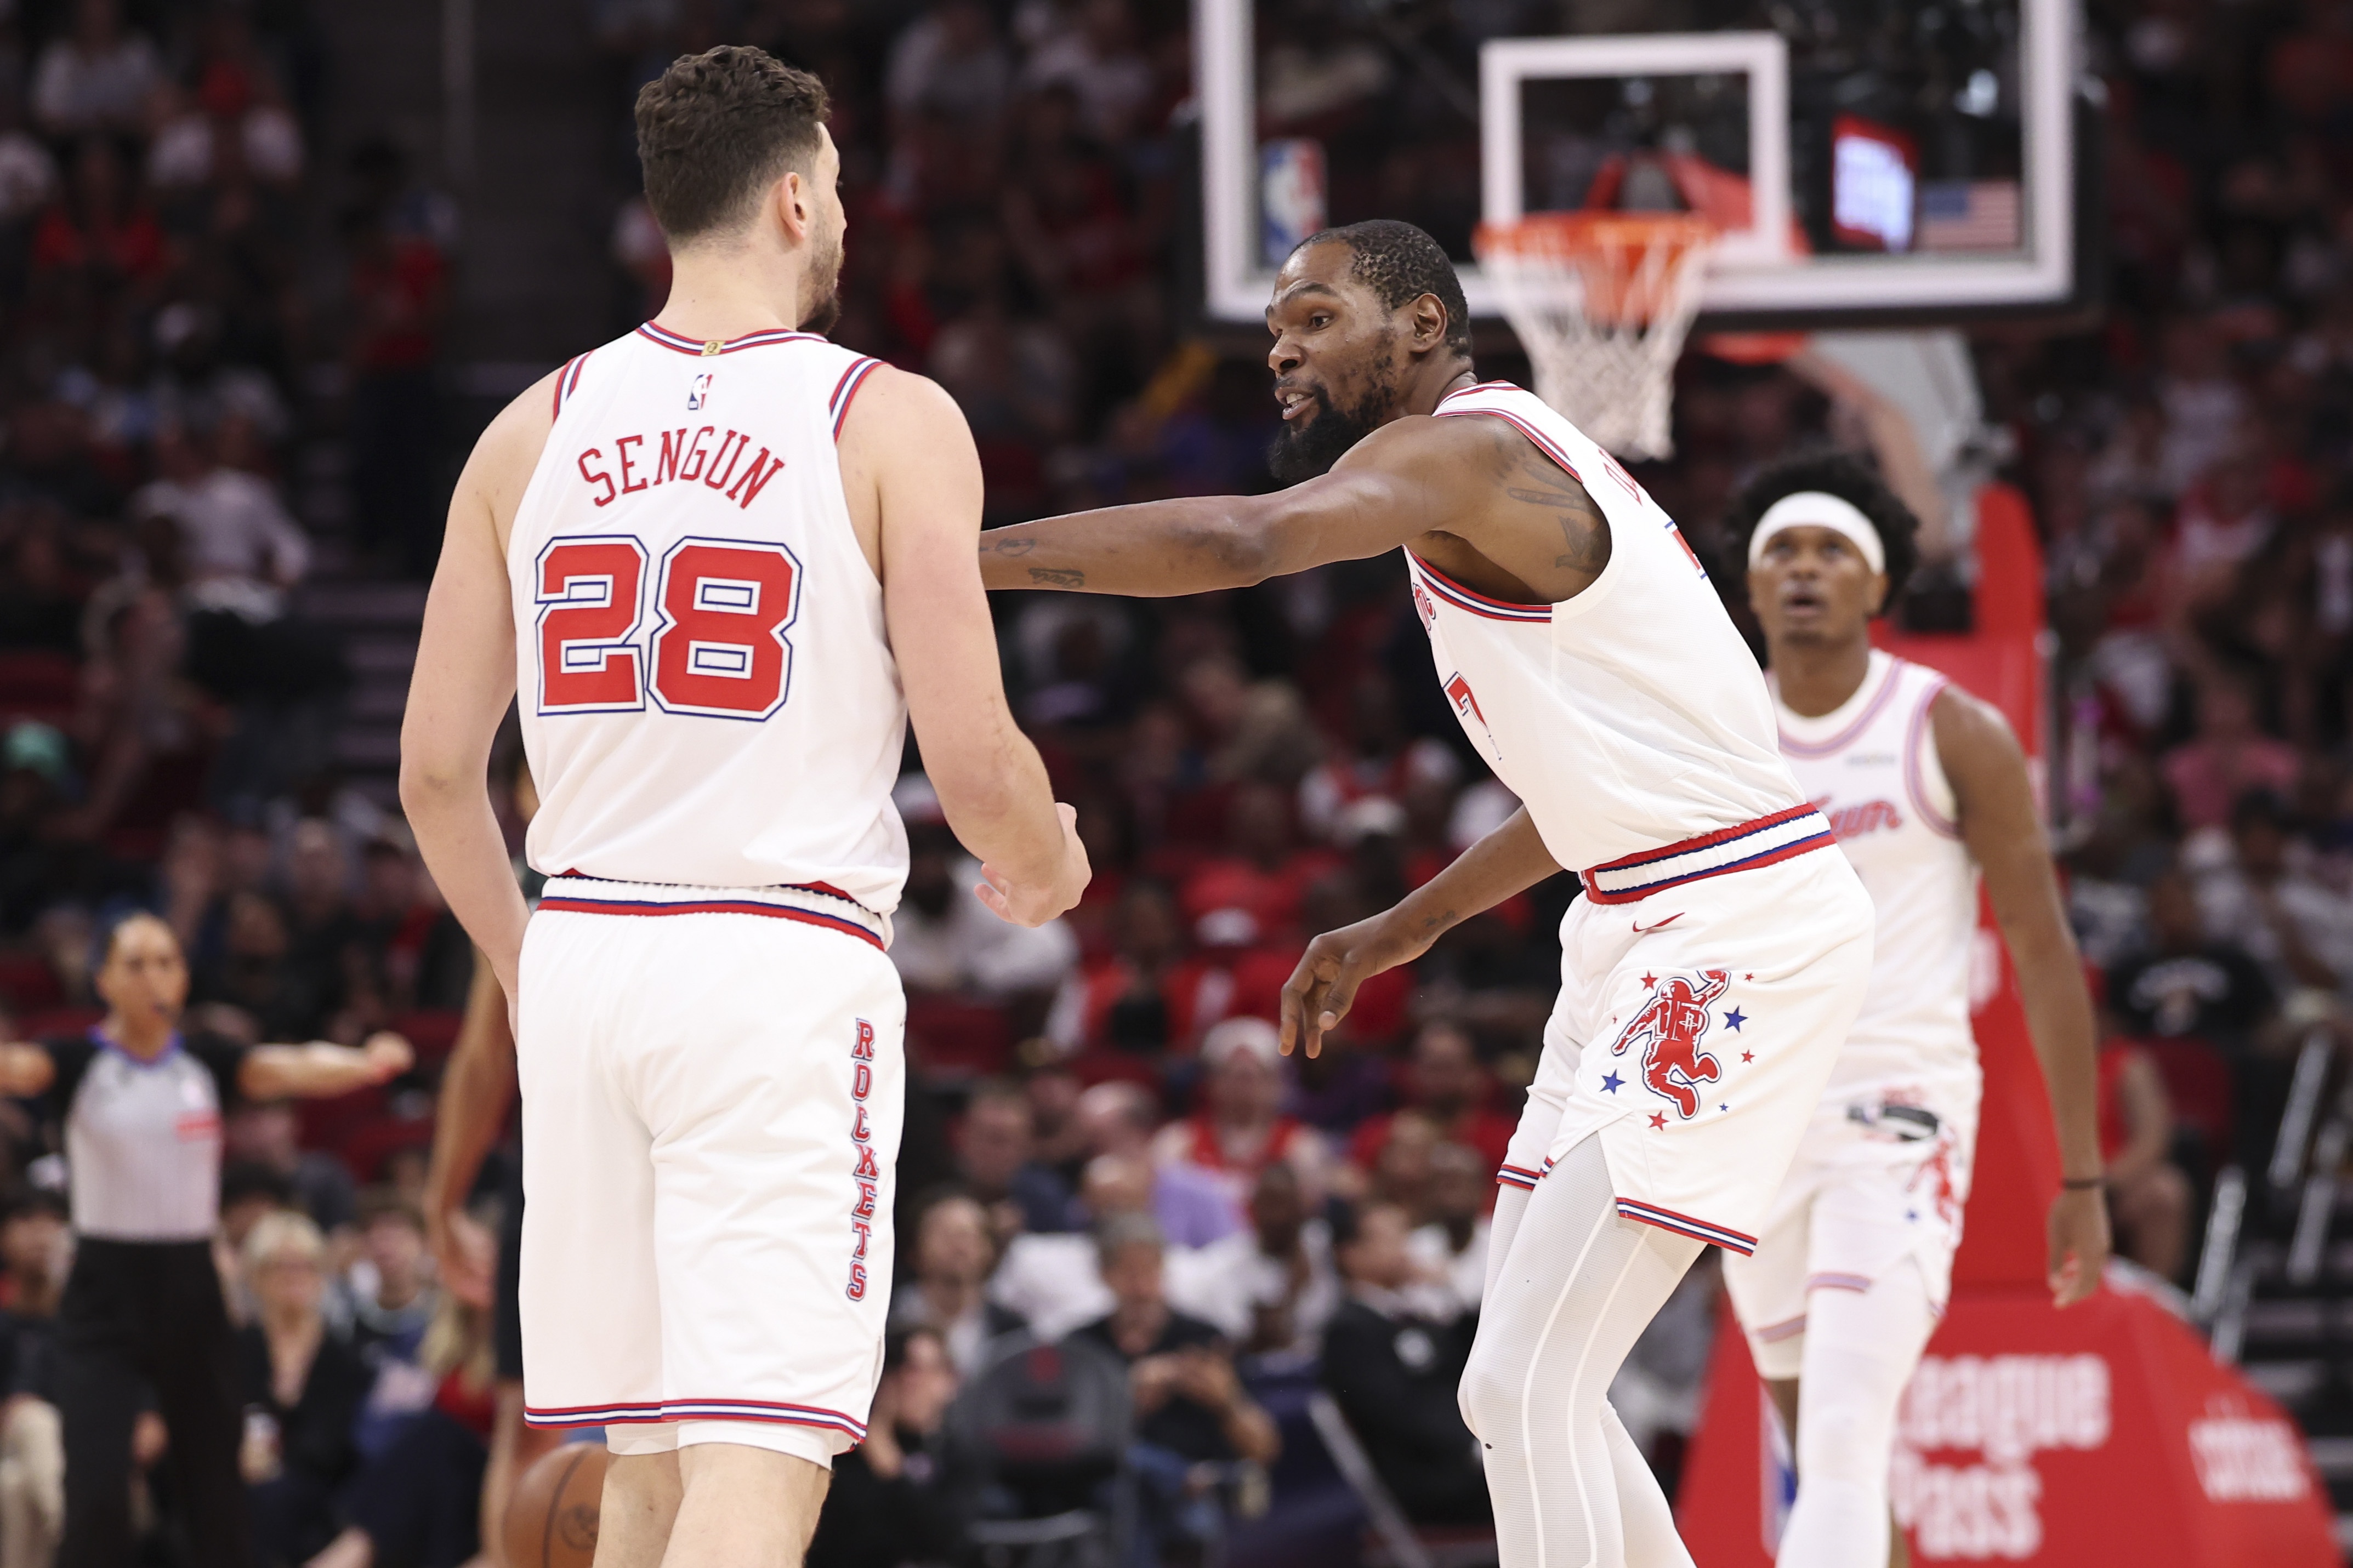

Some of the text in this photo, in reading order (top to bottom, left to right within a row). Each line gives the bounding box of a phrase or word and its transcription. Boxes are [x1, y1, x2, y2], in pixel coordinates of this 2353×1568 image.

[578, 426, 785, 509] SENGUN
[535, 535, 802, 722] 28
[1442, 671, 1502, 761] 7
[846, 1018, 879, 1301] ROCKETS
